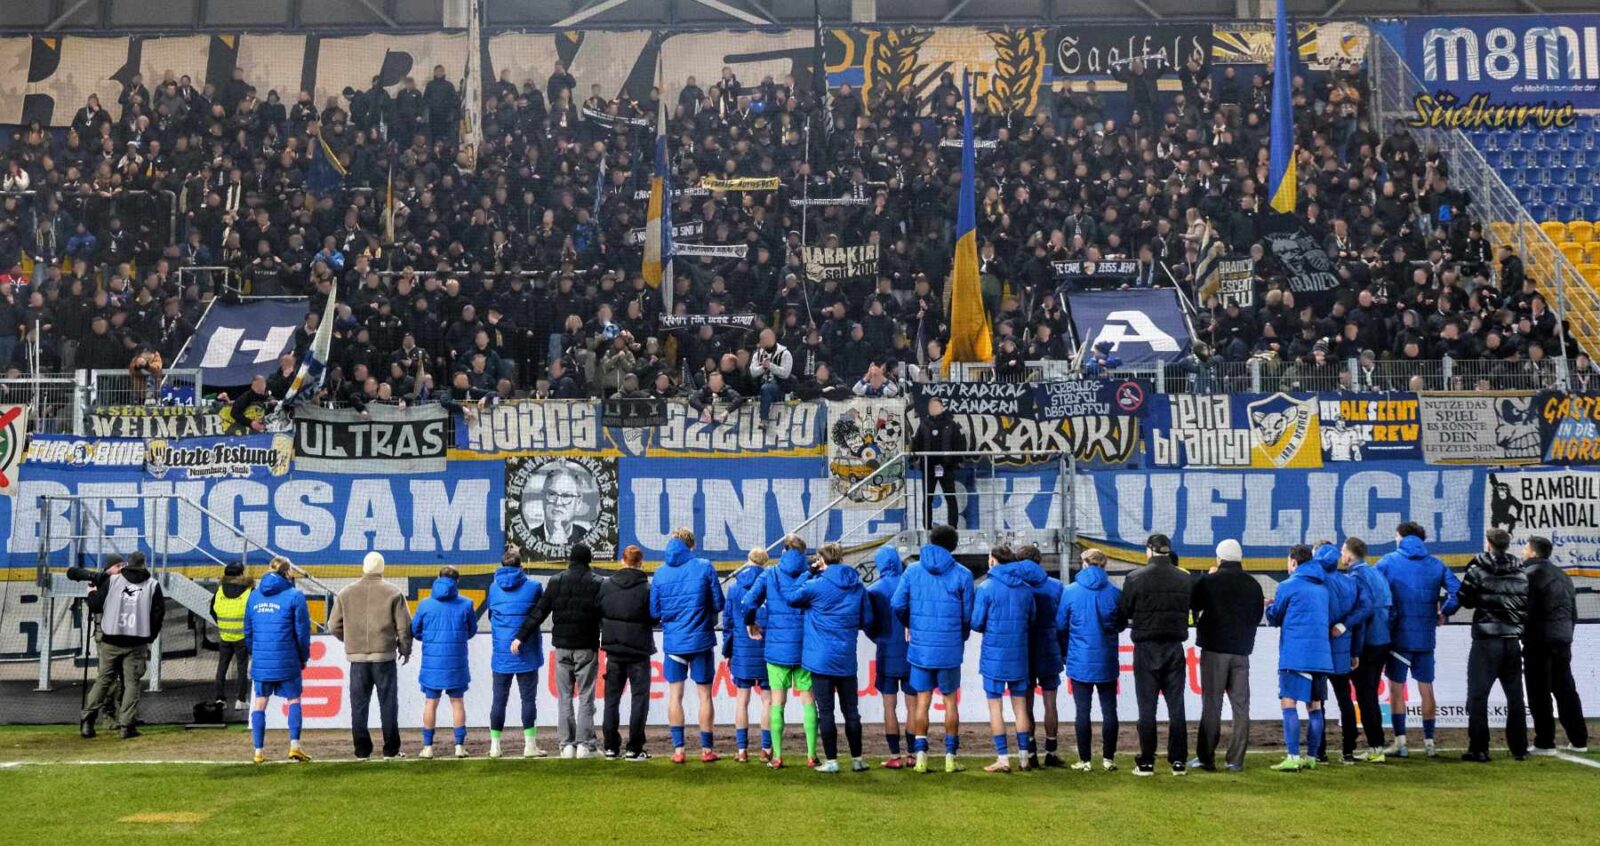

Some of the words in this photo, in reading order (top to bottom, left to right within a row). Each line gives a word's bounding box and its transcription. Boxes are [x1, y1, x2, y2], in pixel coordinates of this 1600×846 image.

[1409, 91, 1576, 129] Südkurve
[922, 383, 956, 397] NOFV
[958, 383, 1027, 398] RADIKAL
[108, 405, 197, 416] SEKTION
[941, 397, 1019, 414] ERÄNDERN
[1425, 401, 1464, 410] NUTZE
[1466, 401, 1487, 410] DAS
[1436, 410, 1478, 422] SPIEL
[90, 414, 225, 438] WEIMAR
[1362, 423, 1419, 441] CREW
[1427, 422, 1439, 431] ES
[1442, 420, 1487, 431] KÖNNTE
[1558, 423, 1572, 437] IN
[1575, 423, 1595, 437] DIE
[301, 421, 443, 457] ULTRAS
[1440, 432, 1477, 442] DEIN
[163, 446, 210, 467] Letzte
[213, 443, 279, 468] Festung
[1426, 444, 1472, 452] LETZTES
[1473, 444, 1497, 452] SEIN
[7, 479, 492, 554] BEUGSAM
[118, 612, 136, 628] 30
